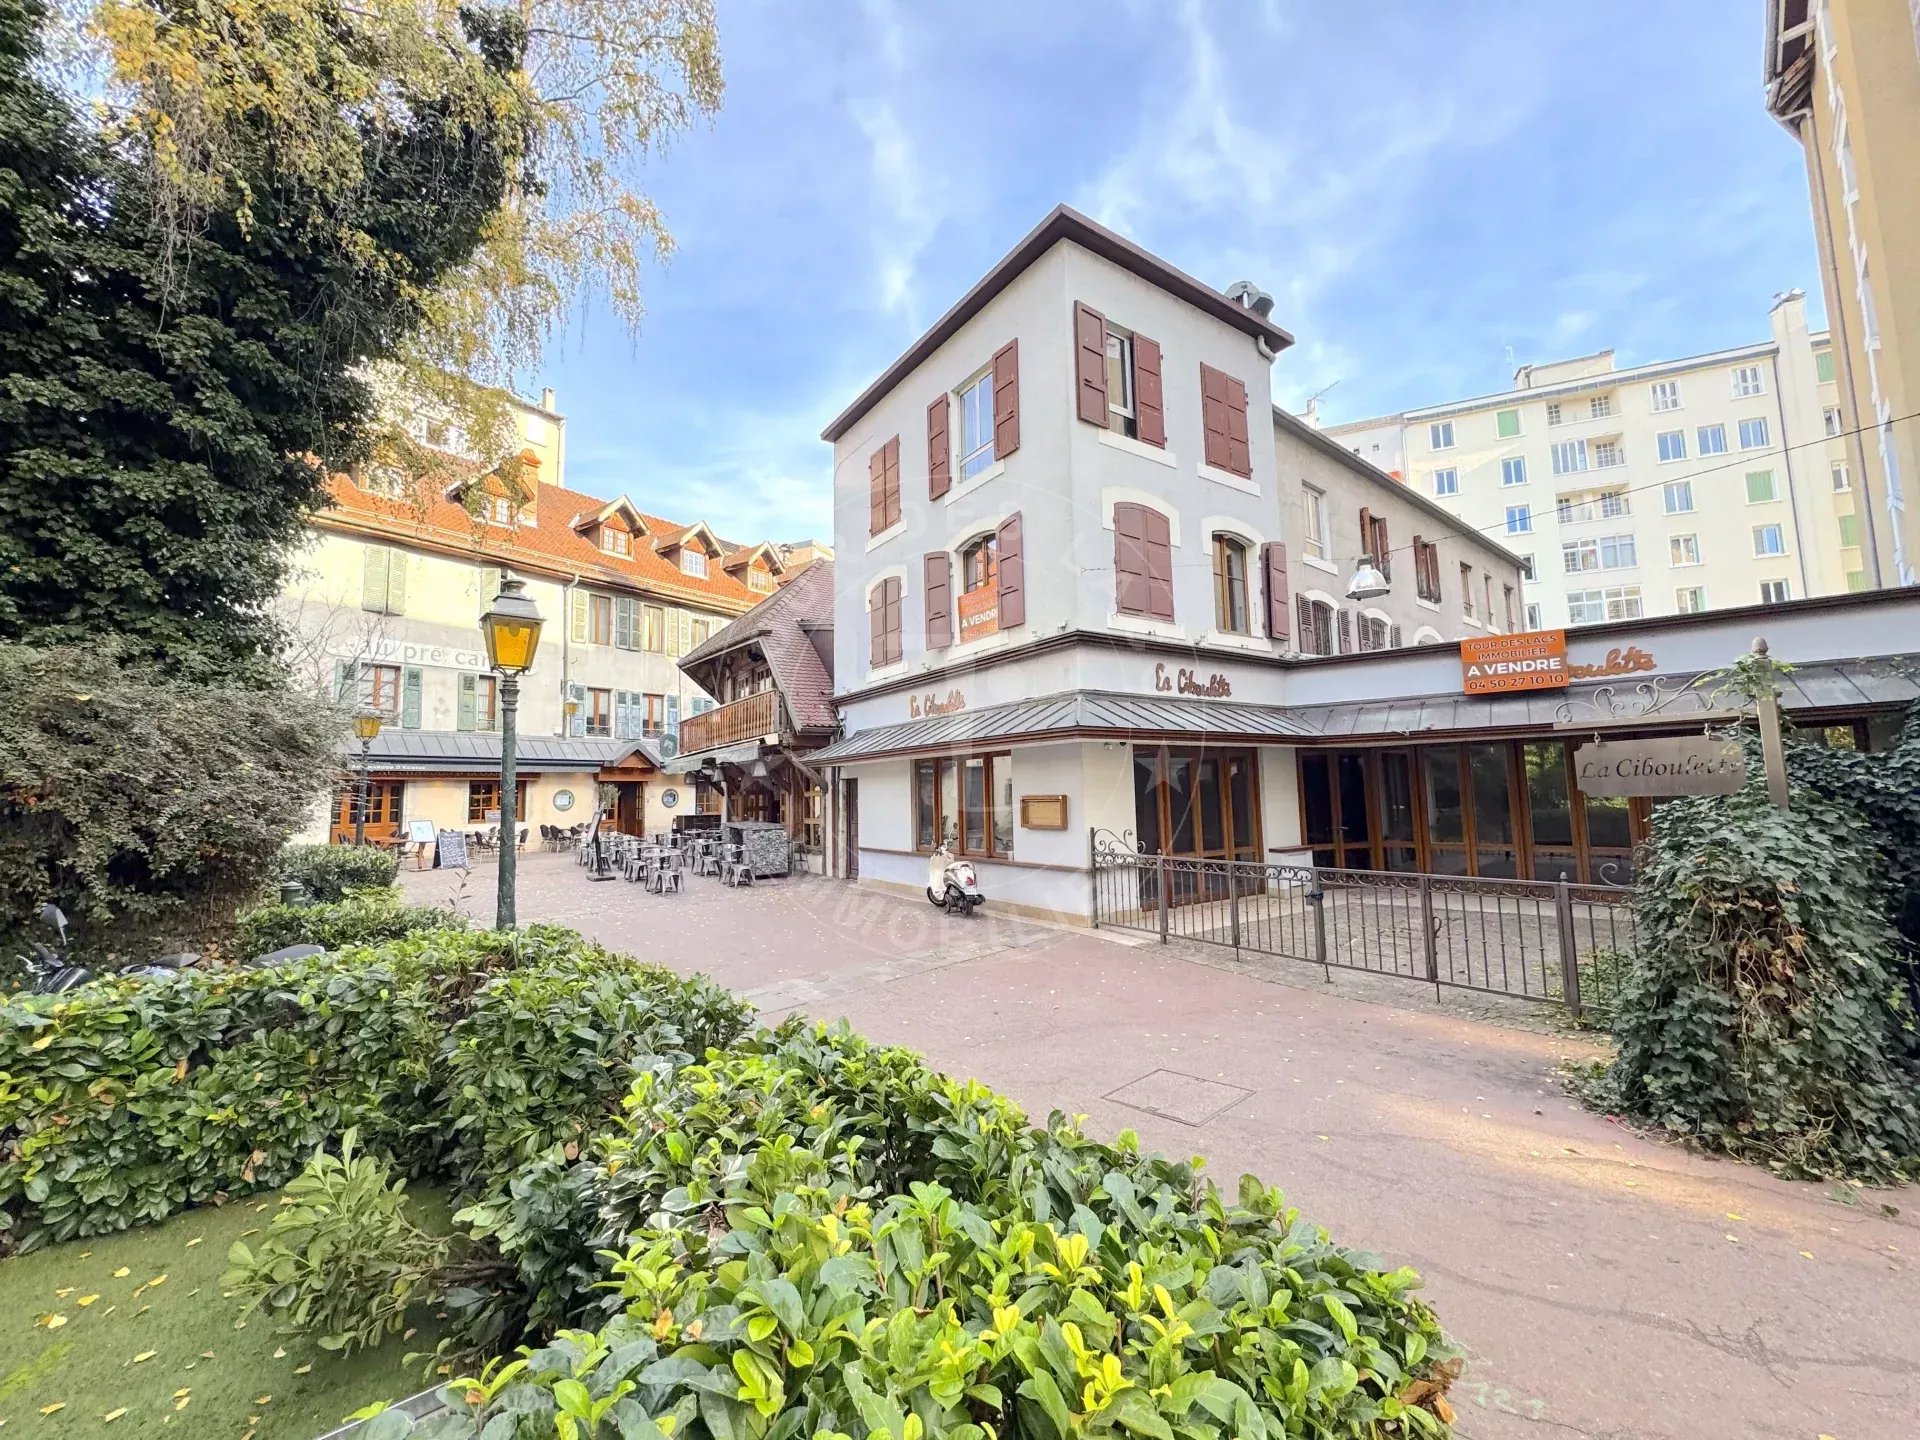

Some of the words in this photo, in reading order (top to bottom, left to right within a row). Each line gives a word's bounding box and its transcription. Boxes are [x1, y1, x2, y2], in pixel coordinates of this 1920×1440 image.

[961, 618, 968, 628] A
[969, 608, 997, 626] VENDR
[1468, 641, 1498, 651] TOUR
[1501, 639, 1523, 648] DES
[1527, 635, 1556, 645] LACS
[1478, 647, 1546, 660] IMMOBILIER
[1467, 665, 1480, 677] A
[1484, 657, 1562, 675] VENDRE
[1469, 681, 1485, 690] 04
[1490, 679, 1506, 688] 50
[1511, 677, 1525, 687] 27
[1529, 676, 1545, 685] 10
[1549, 674, 1564, 683] 10
[1579, 762, 1610, 779] La
